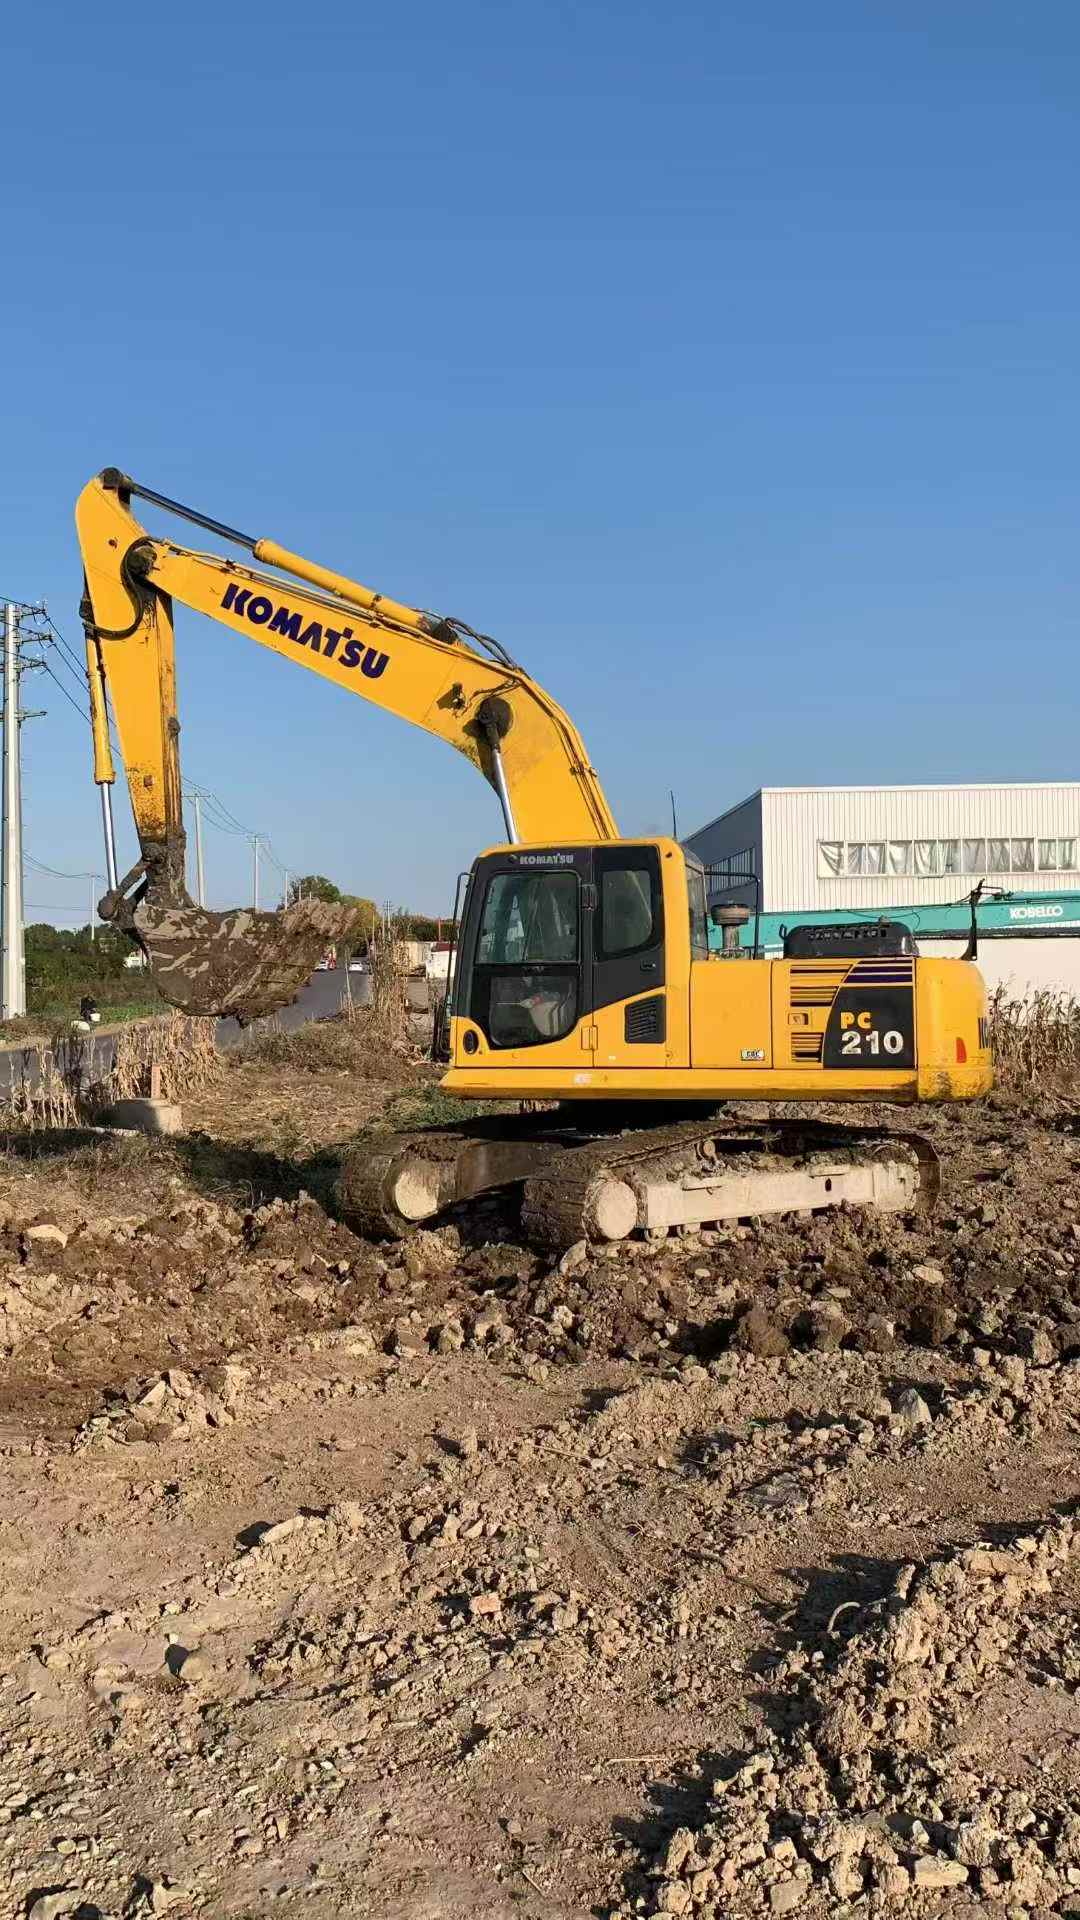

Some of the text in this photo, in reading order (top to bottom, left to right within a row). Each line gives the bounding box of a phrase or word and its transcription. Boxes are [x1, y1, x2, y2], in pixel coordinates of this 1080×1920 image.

[220, 583, 390, 678] KOMATSU
[520, 854, 574, 864] KOMATSU
[1010, 905, 1063, 919] KOBELCO
[840, 1012, 871, 1029] PC
[842, 1031, 904, 1054] 210
